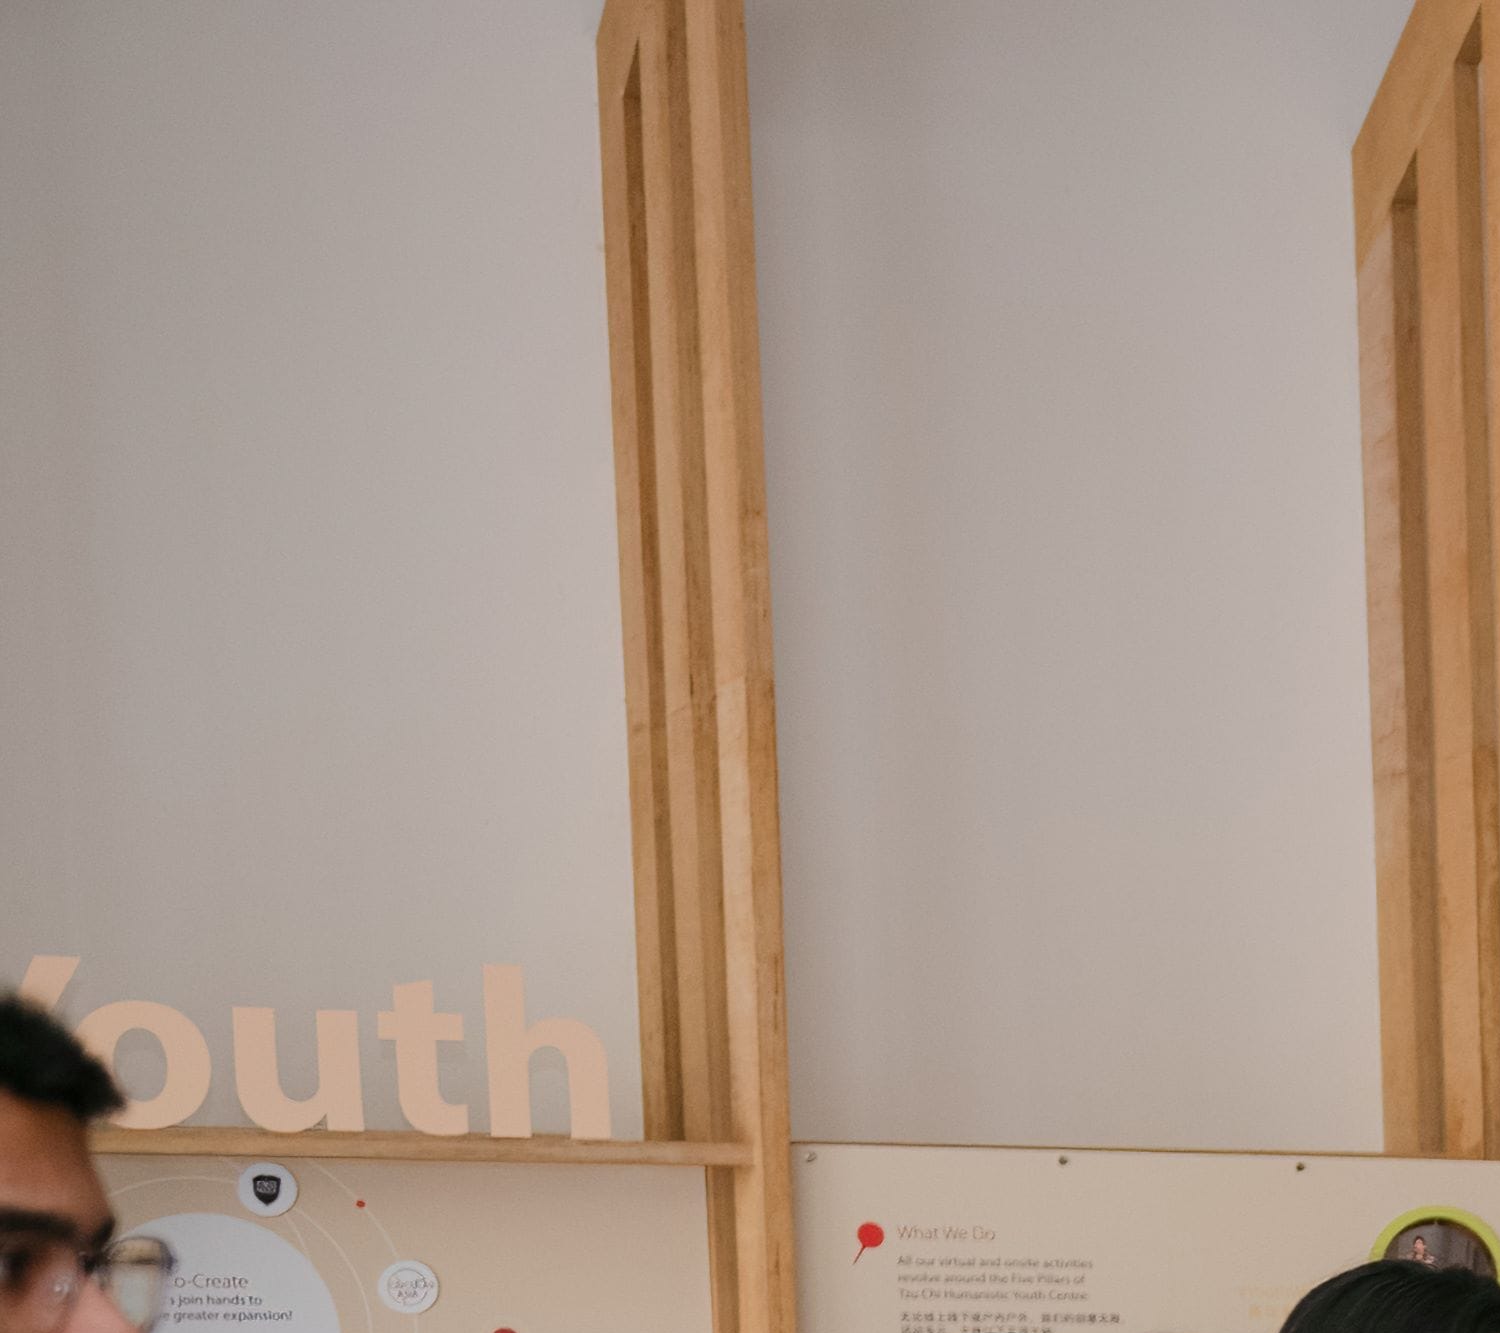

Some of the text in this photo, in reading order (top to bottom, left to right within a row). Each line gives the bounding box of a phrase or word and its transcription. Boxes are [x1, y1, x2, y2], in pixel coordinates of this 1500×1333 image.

[898, 1226, 996, 1241] What We Do
[174, 1273, 249, 1289] o-Create
[206, 1295, 245, 1306] hands
[173, 1310, 219, 1323] greater
[223, 1310, 293, 1323] expansion!
